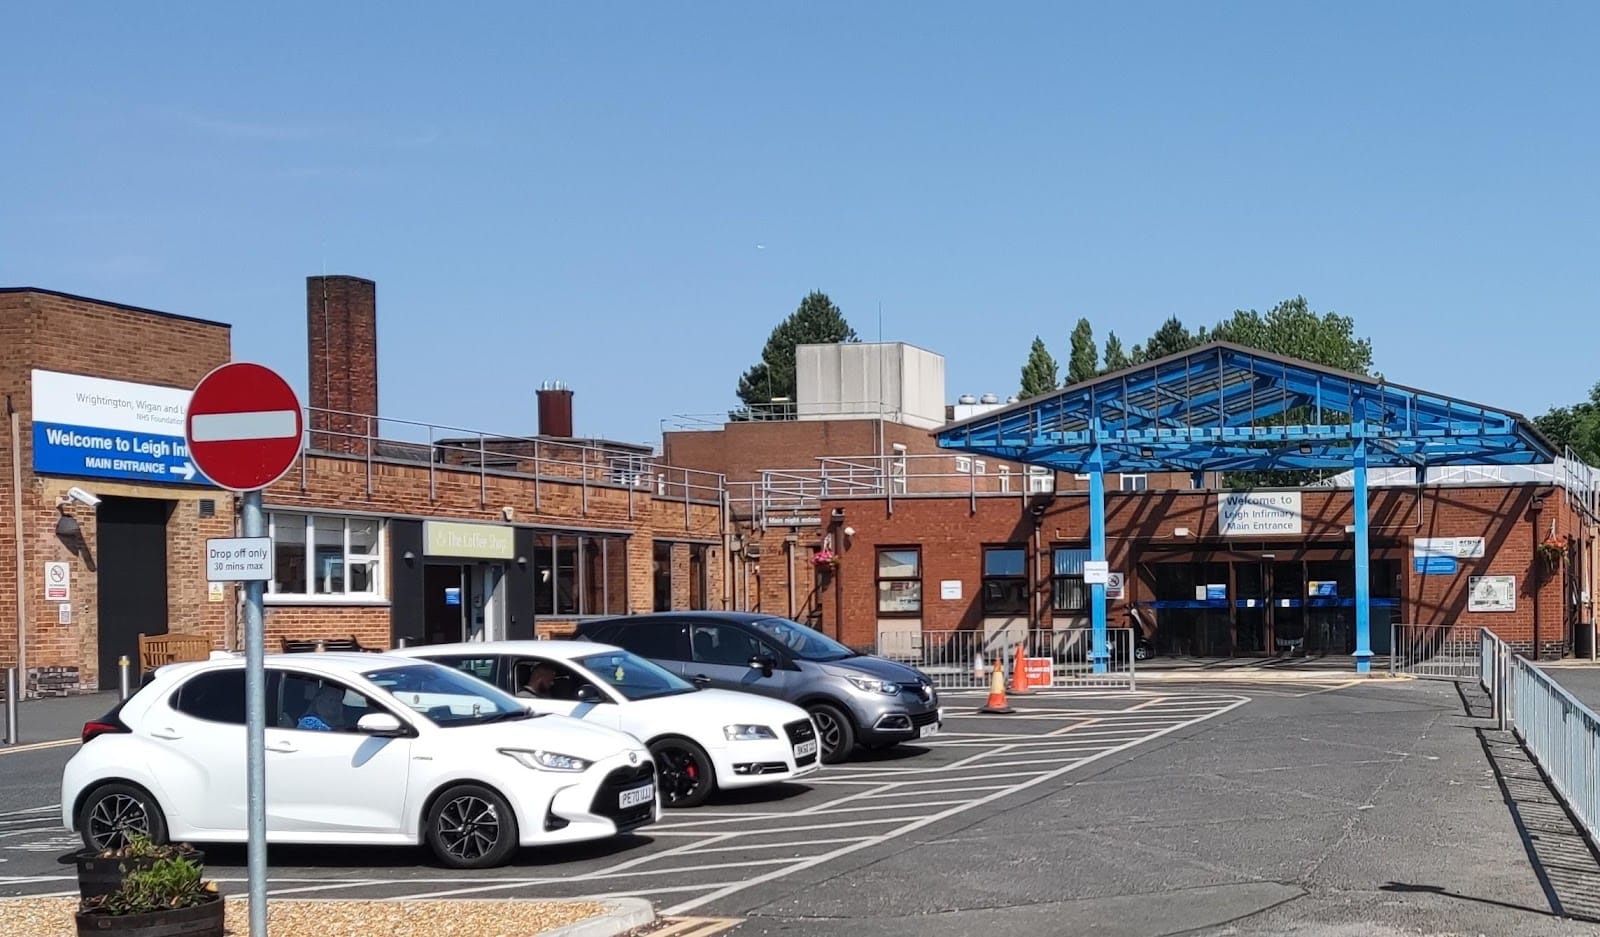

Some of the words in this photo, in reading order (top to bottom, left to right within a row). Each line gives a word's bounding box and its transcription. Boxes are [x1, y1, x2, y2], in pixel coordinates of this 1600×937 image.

[76, 392, 134, 410] Wrightington,
[136, 400, 162, 413] Wigan
[163, 404, 179, 413] and
[136, 413, 150, 422] NHS
[46, 428, 113, 450] Welcome
[116, 436, 130, 452] to
[133, 437, 170, 458] Leigh
[85, 456, 112, 469] MAIN
[114, 460, 166, 474] ENTRANCE
[1226, 496, 1276, 505] Welcome
[1281, 496, 1293, 504] to
[1224, 511, 1249, 520] Leigh
[1252, 510, 1295, 518] Infirmary
[1227, 522, 1250, 530] Main
[1253, 522, 1294, 530] Entrance
[210, 549, 232, 560] Drop
[234, 548, 246, 558] off
[248, 548, 268, 560] only
[214, 562, 223, 571] 30
[225, 562, 245, 570] mins
[622, 790, 640, 806] PE70
